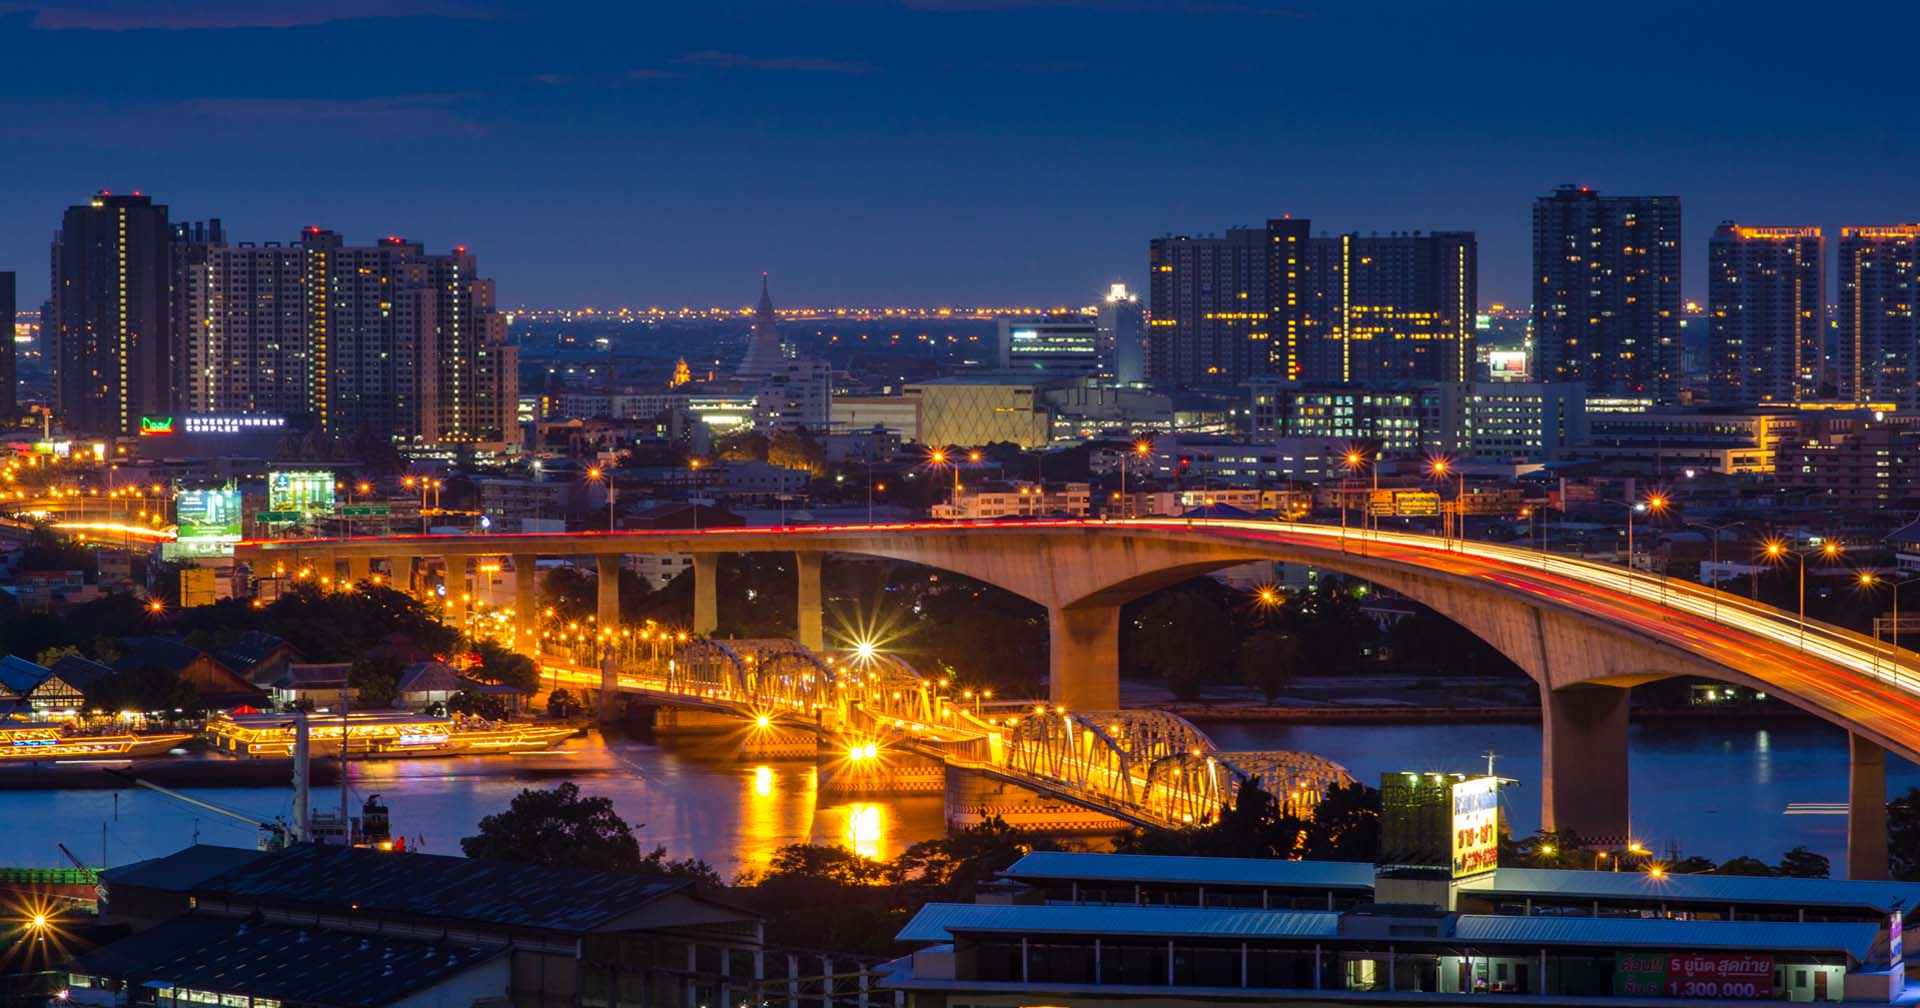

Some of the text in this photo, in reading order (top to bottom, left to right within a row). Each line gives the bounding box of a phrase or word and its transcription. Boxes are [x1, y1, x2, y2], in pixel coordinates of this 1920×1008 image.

[185, 418, 286, 426] ENTERTAINMENT
[185, 425, 240, 433] COMPLEX
[1671, 958, 1680, 971] 5
